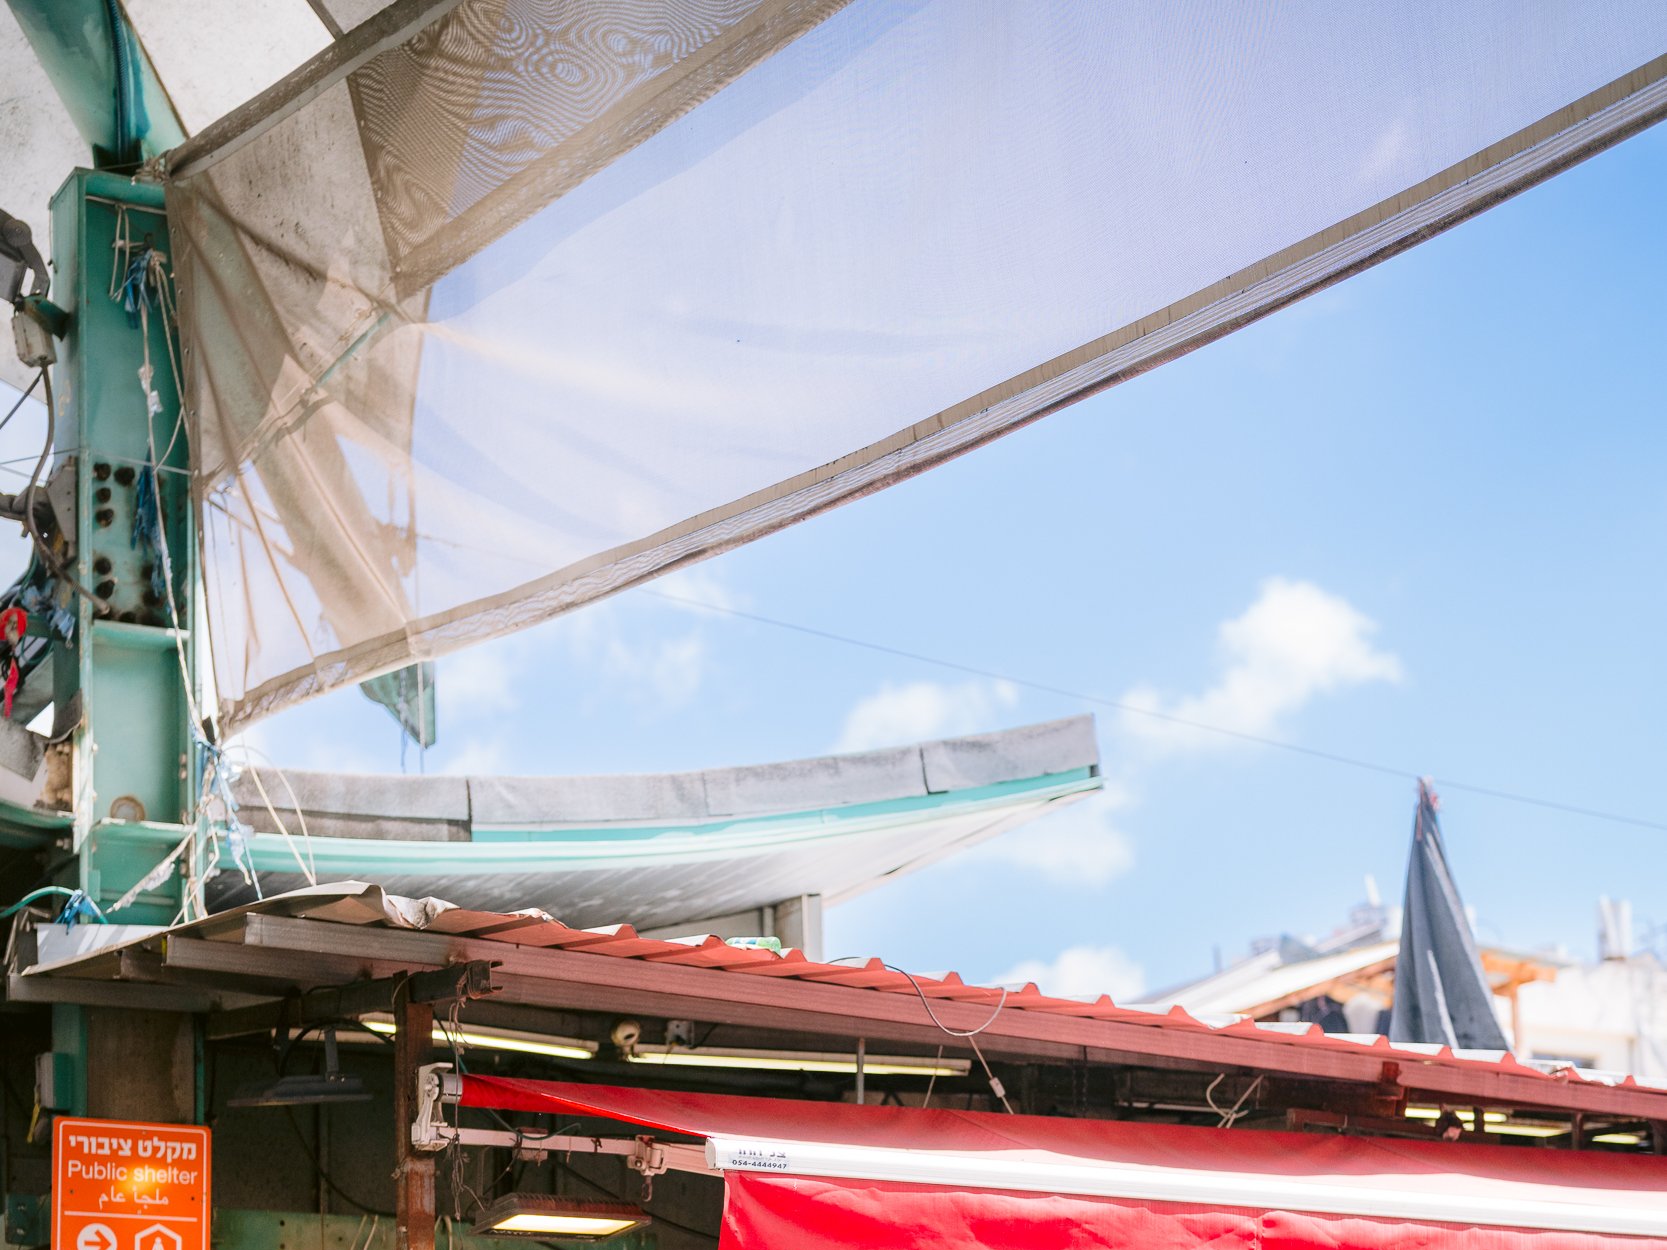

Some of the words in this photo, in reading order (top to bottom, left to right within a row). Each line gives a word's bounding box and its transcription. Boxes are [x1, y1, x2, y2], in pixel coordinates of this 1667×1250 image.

[69, 1134, 132, 1157] ציבורי
[137, 1136, 197, 1161] מקלט
[66, 1159, 128, 1181] Public
[133, 1164, 198, 1185] shelter
[732, 1159, 787, 1170] 054-4444947
[98, 1185, 126, 1209] عام
[131, 1184, 169, 1209] ملجأ
